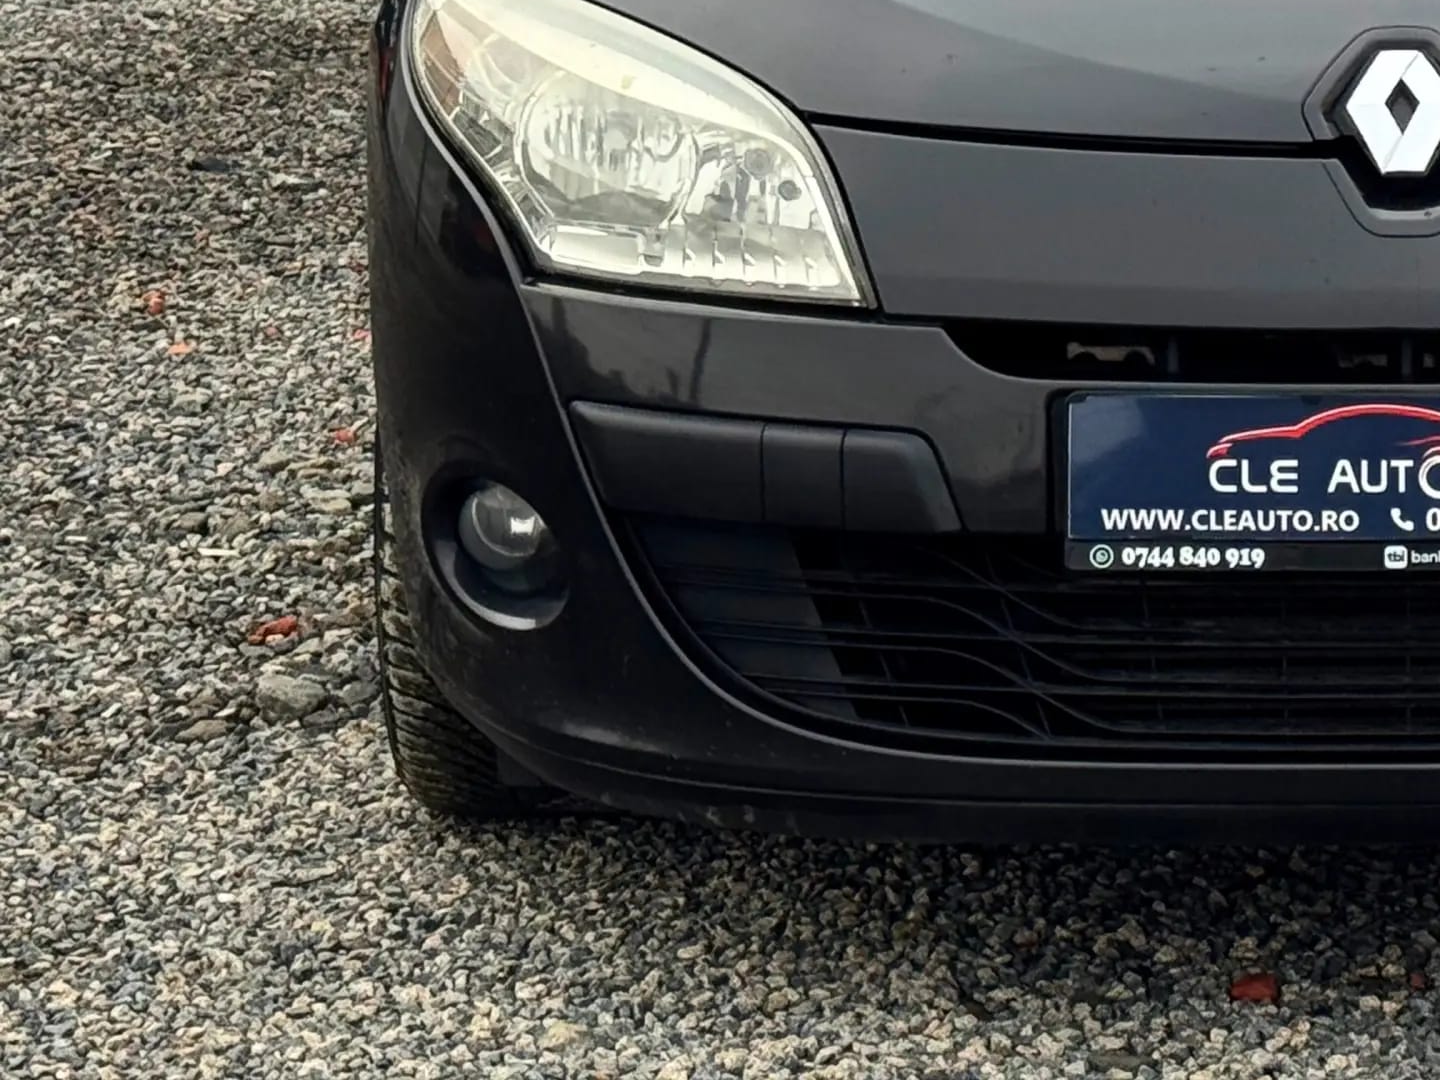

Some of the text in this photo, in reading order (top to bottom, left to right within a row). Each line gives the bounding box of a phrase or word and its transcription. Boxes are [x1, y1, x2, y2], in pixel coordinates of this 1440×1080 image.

[1207, 458, 1300, 494] CLE
[1100, 507, 1361, 533] WWW.CLEAUTO.RO
[1121, 546, 1266, 569] 0744 840 919
